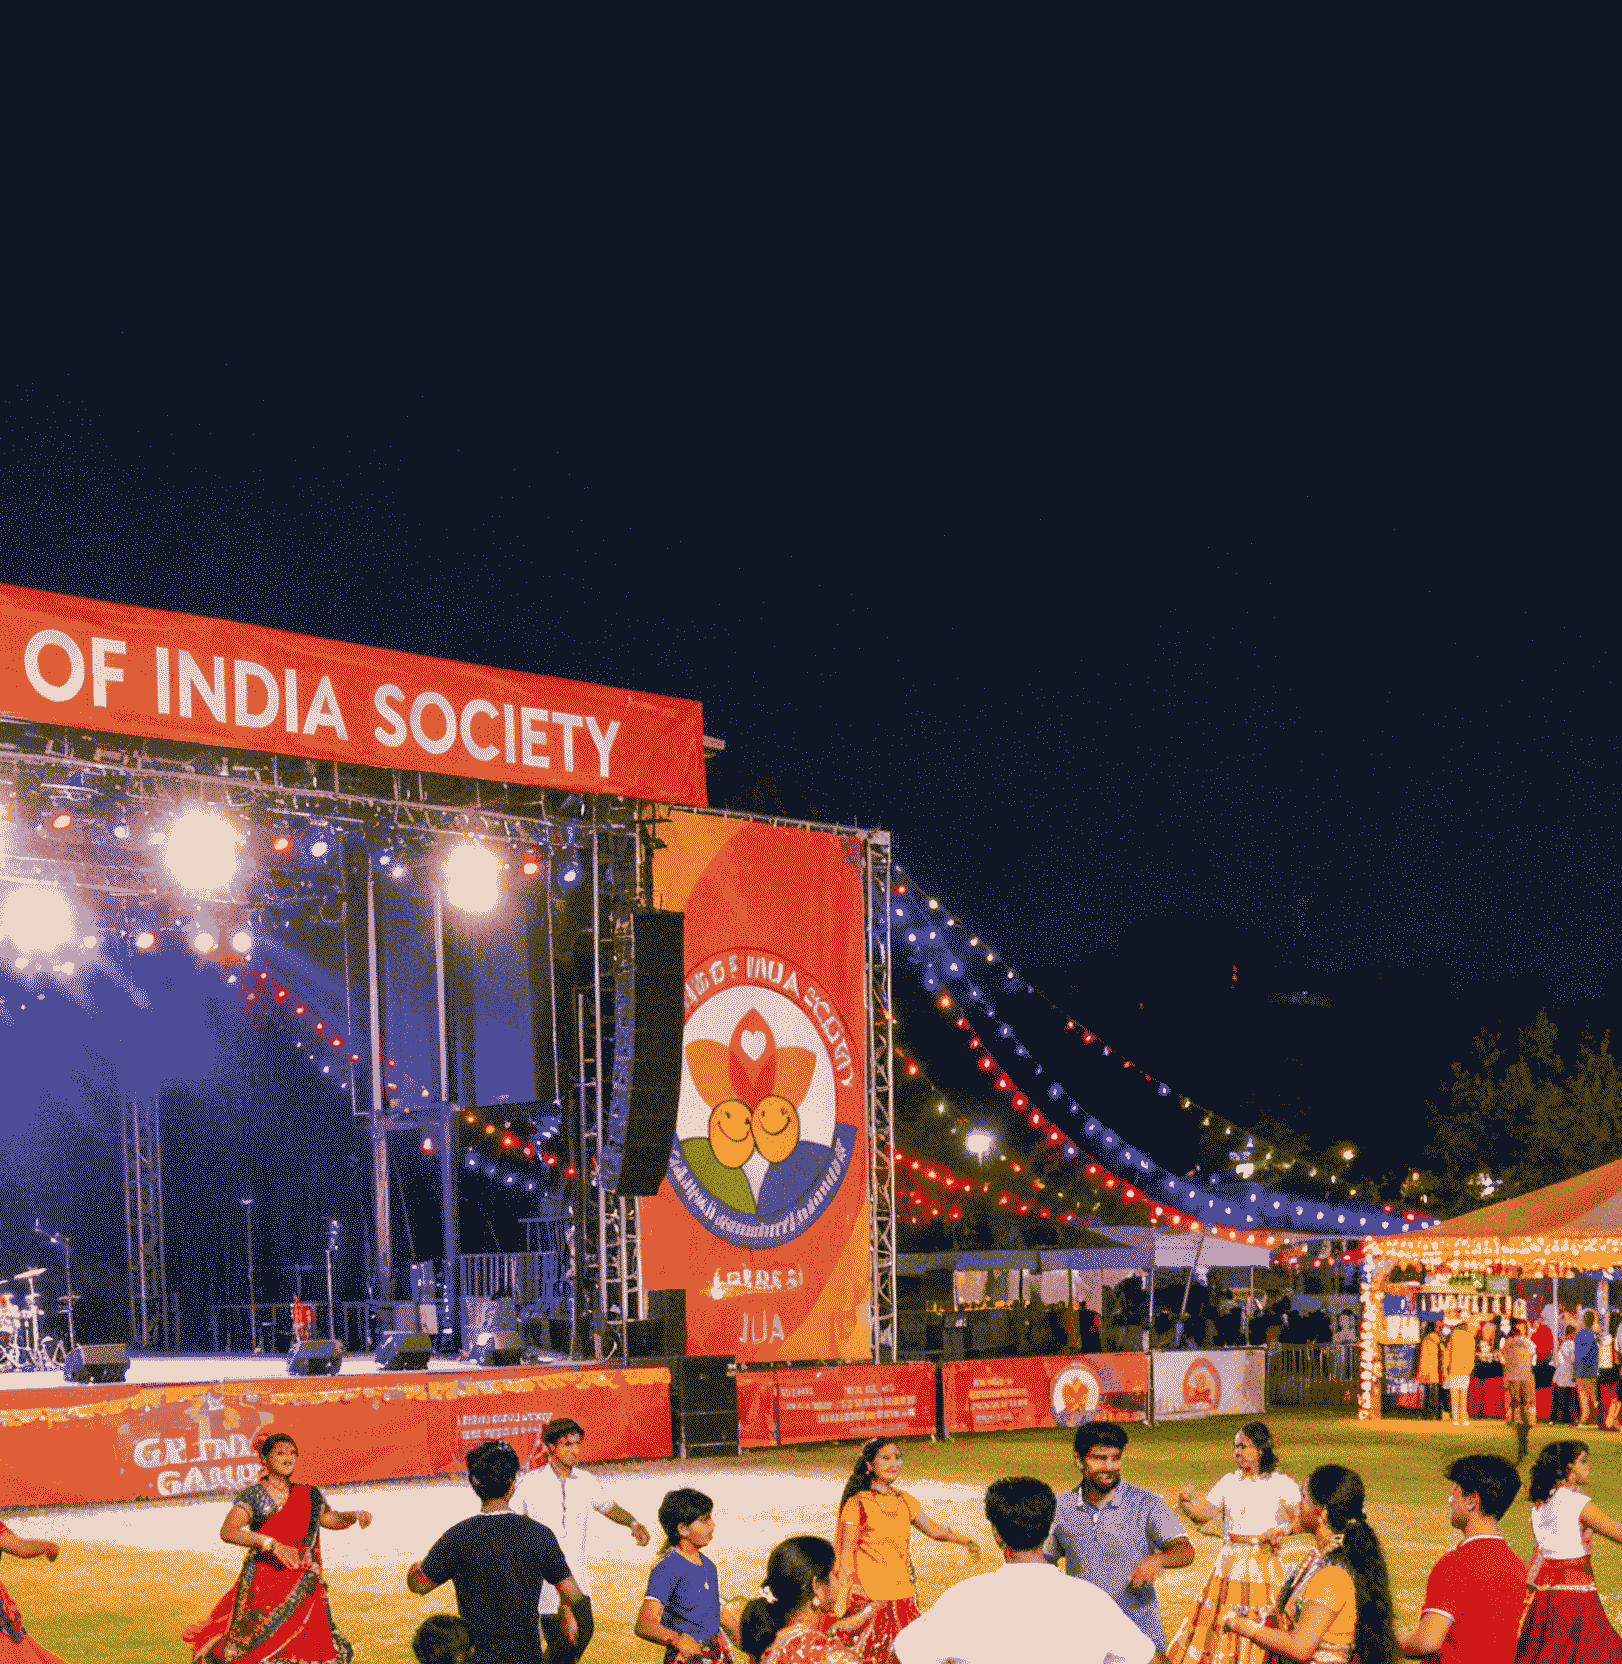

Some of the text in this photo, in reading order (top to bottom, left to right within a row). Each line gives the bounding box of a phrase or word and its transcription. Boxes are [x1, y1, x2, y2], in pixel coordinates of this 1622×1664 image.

[24, 629, 127, 708] OF
[156, 646, 349, 741] INDIA
[374, 684, 621, 778] SOCIETY
